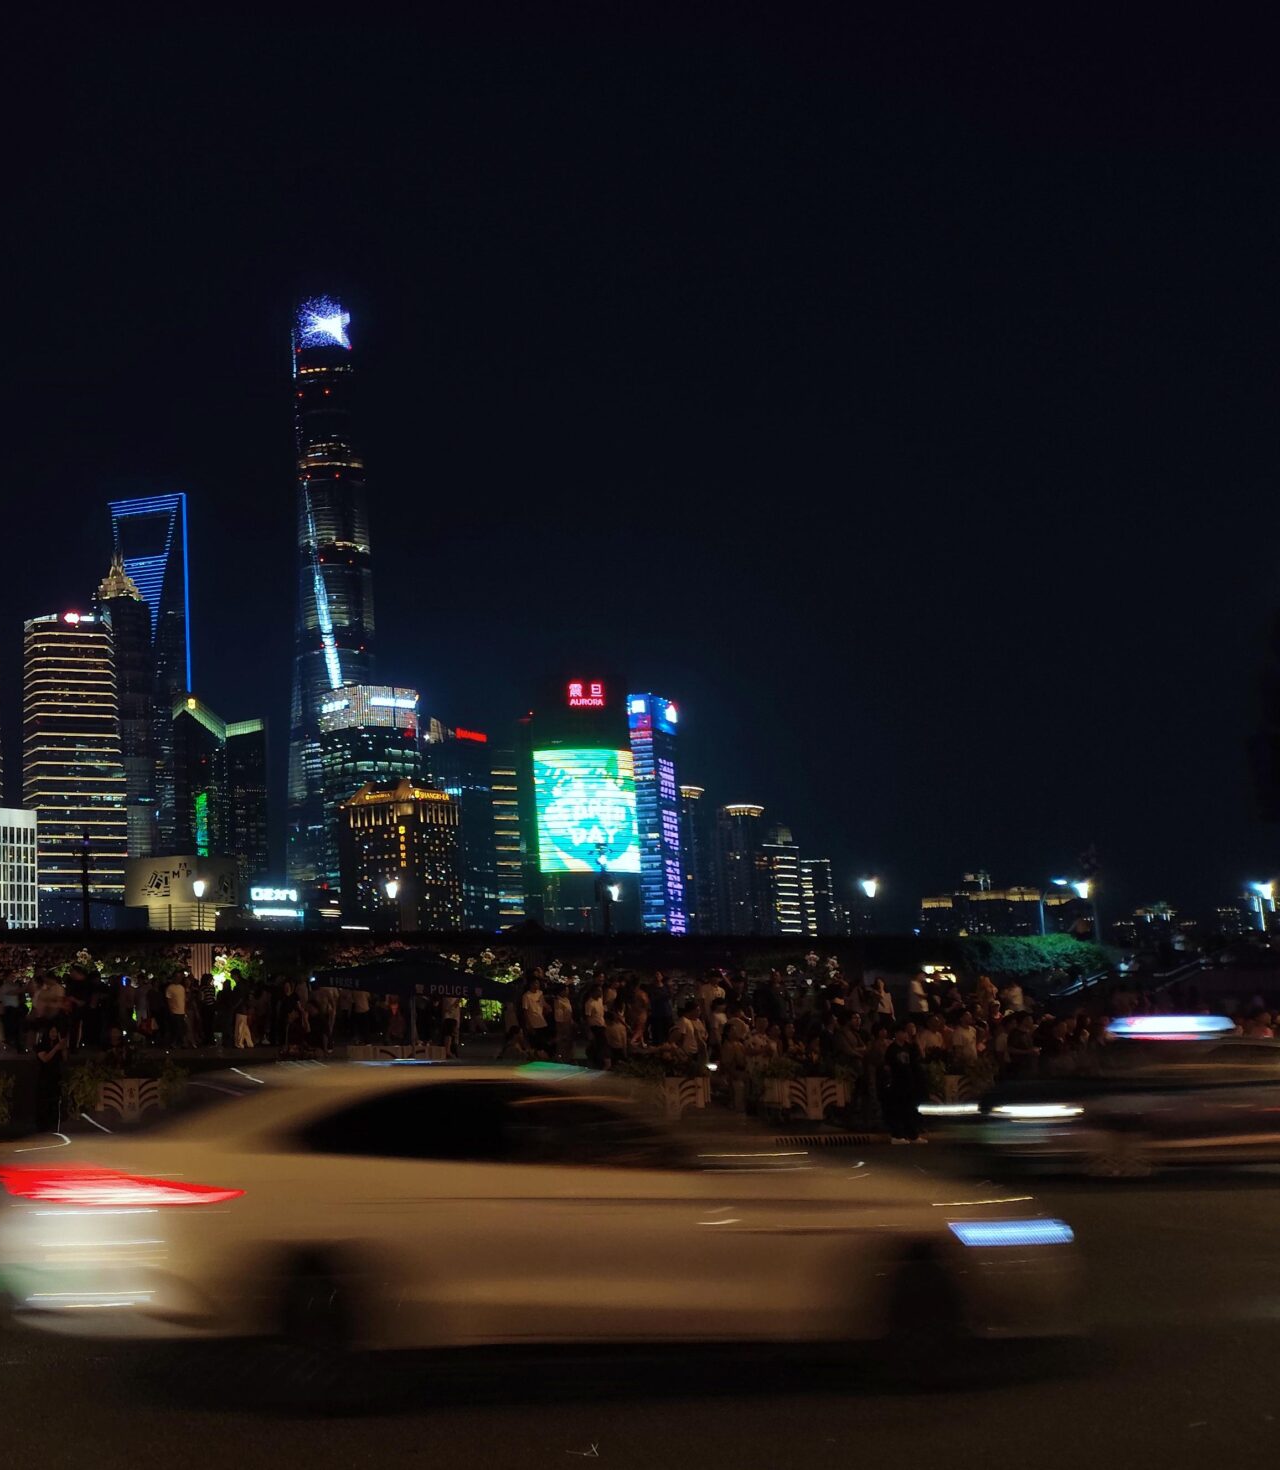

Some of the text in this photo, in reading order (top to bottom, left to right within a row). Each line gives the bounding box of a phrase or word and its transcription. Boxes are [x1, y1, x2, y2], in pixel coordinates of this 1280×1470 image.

[569, 683, 602, 697] 震旦
[570, 698, 603, 706] AURORA
[568, 825, 618, 846] DAY
[430, 984, 469, 996] POLICE
